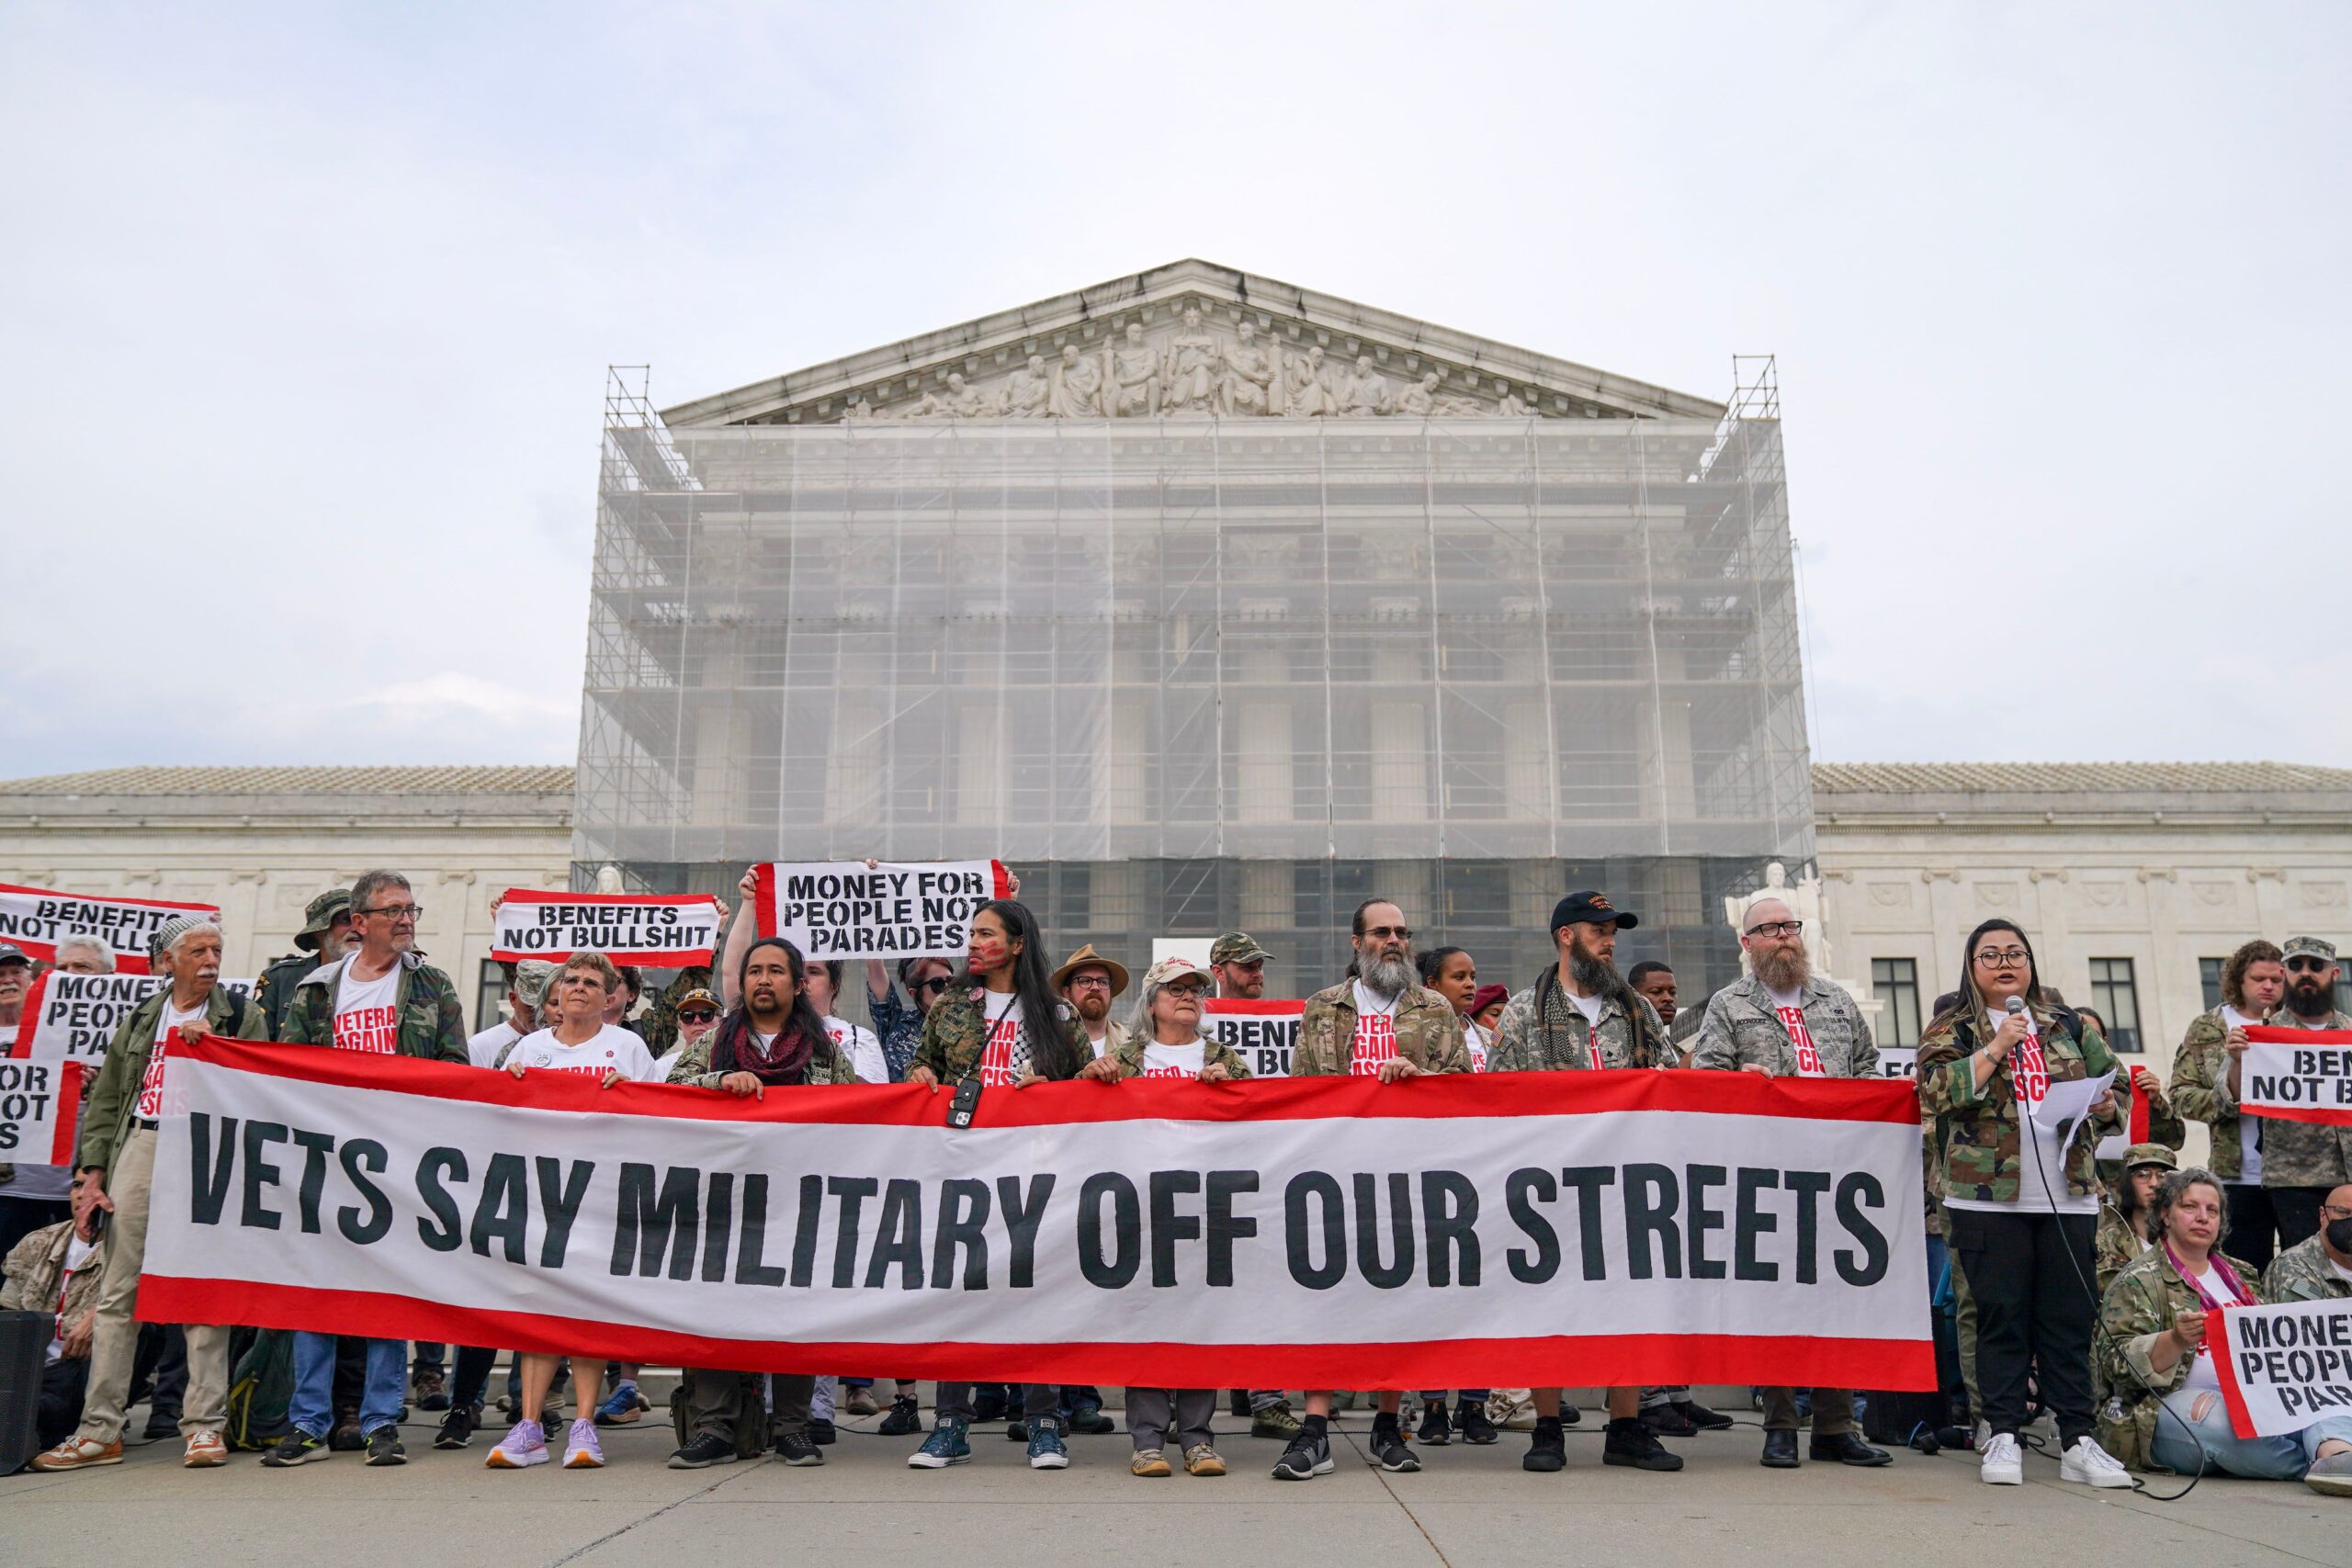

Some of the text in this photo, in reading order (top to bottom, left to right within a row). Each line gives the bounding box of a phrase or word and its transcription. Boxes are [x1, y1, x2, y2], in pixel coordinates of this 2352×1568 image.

[787, 872, 984, 900] MONEY FOR
[0, 913, 61, 940] NOT
[36, 900, 182, 931] BENEFIT
[538, 906, 679, 926] BENEFITS
[784, 899, 913, 928] PEOPLE
[503, 926, 711, 949] NOT BULLSHIT
[810, 924, 965, 953] PARADES
[2293, 1050, 2352, 1077] BE
[2252, 1075, 2325, 1102] NOT
[190, 1112, 1891, 1292] VETS SAY MILITARY OFF OUR STREETS
[2238, 1314, 2352, 1348] MONE
